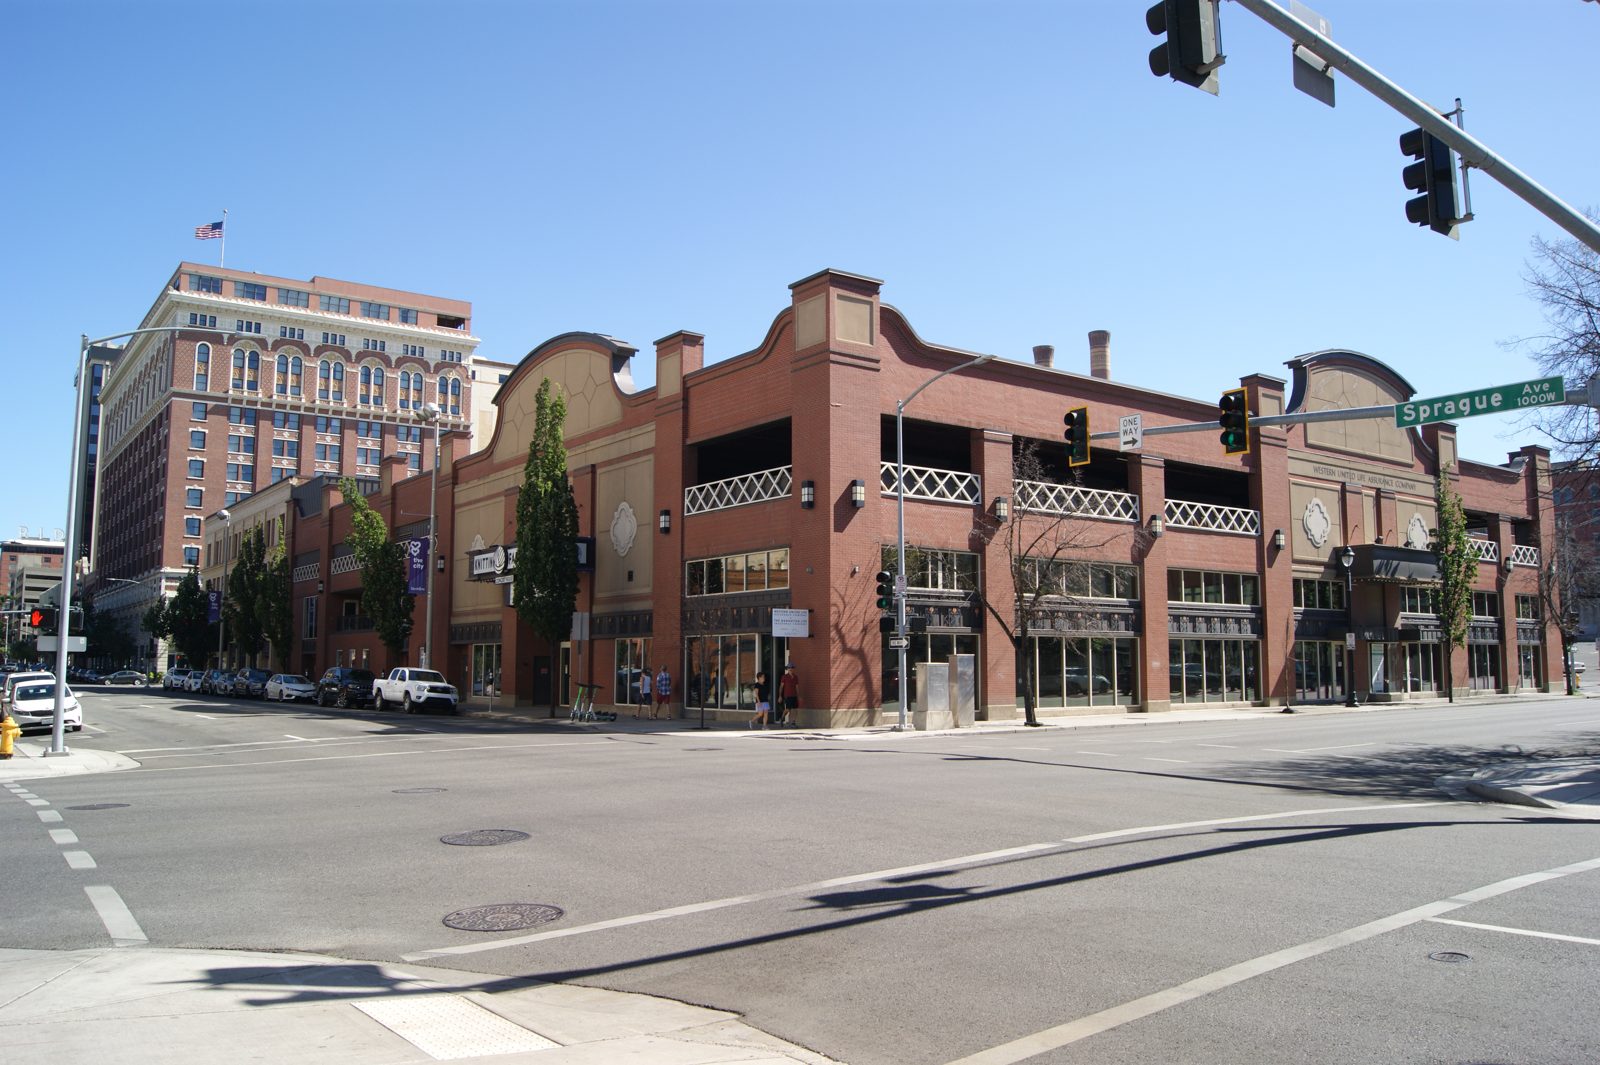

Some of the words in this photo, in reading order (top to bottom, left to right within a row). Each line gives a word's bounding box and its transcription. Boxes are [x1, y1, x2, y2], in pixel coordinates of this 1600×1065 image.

[1403, 392, 1503, 422] Sprague
[1522, 382, 1550, 395] Ave
[1517, 391, 1556, 406] 1000W
[1122, 417, 1138, 427] ONE
[1122, 427, 1139, 436] WAY
[1312, 464, 1336, 477] WESTERN
[1337, 469, 1356, 480] UNITED
[412, 563, 424, 571] city
